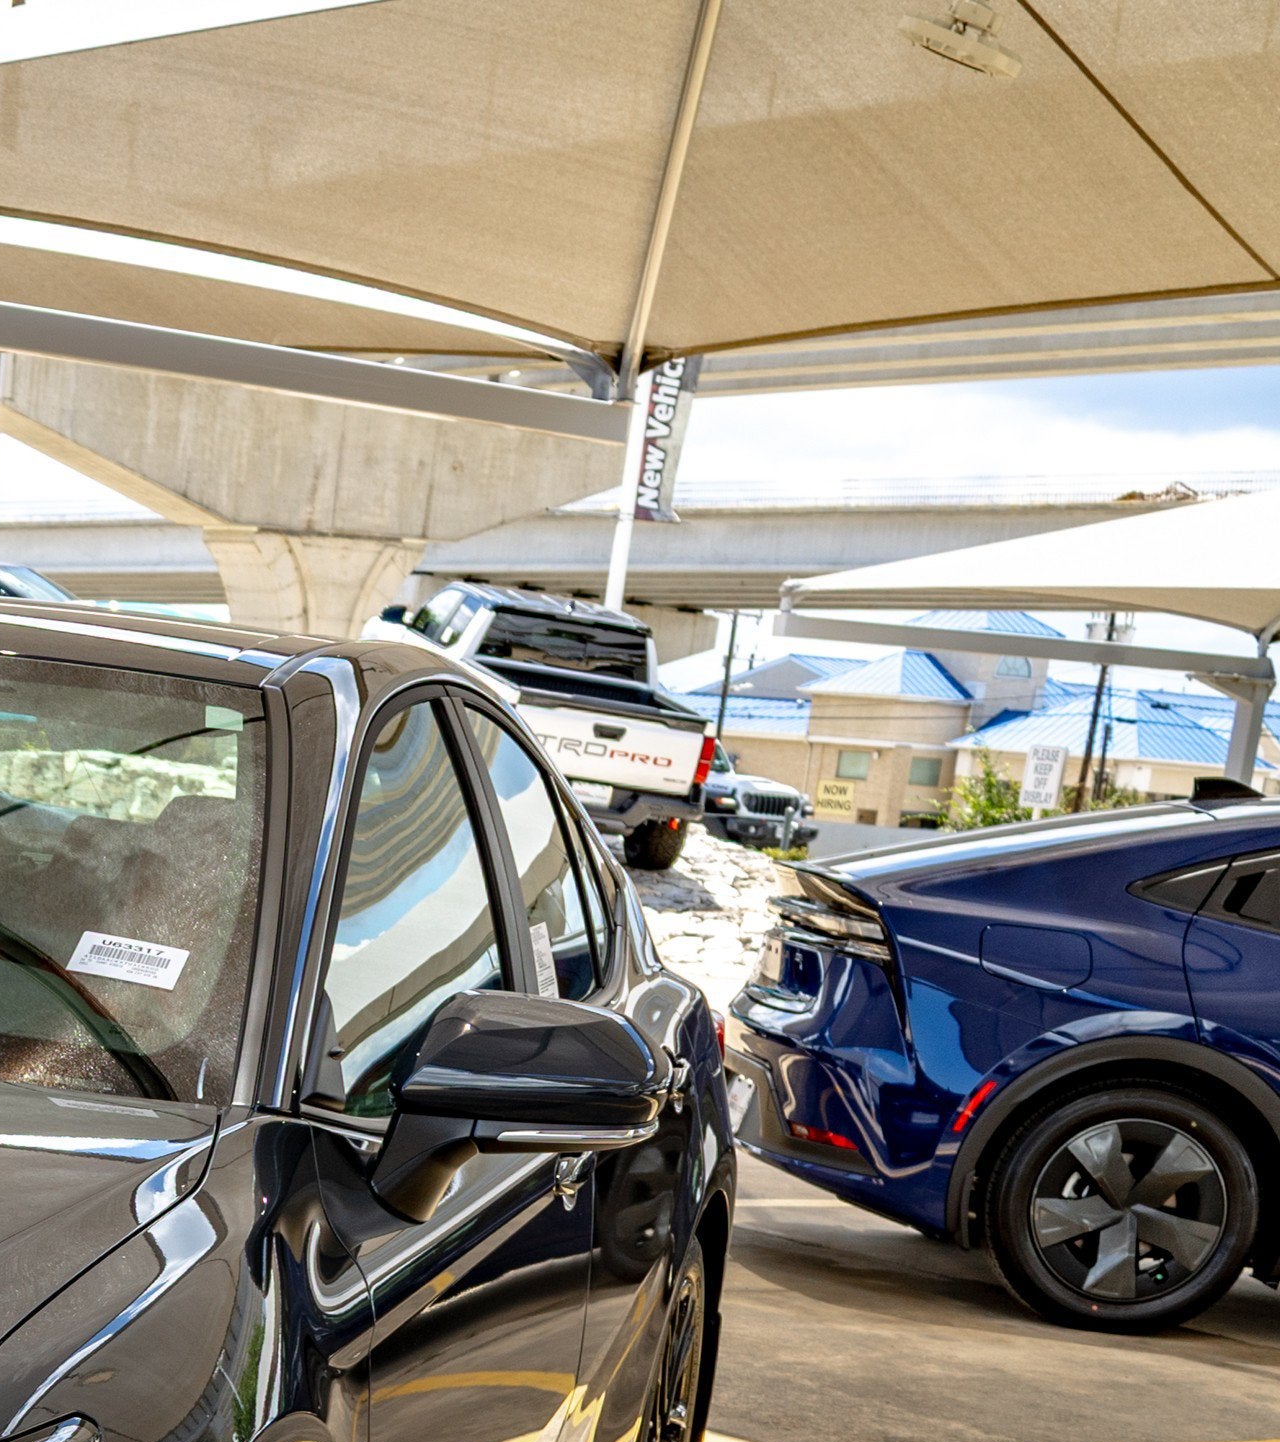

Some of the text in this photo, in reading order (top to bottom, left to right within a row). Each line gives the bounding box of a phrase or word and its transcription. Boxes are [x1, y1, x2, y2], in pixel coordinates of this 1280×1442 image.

[637, 444, 666, 510] New
[537, 734, 673, 768] TRD PRO
[1033, 762, 1054, 776] KEEP
[823, 784, 849, 796] NOW
[816, 799, 852, 811] HIRING
[102, 940, 164, 956] U63317
